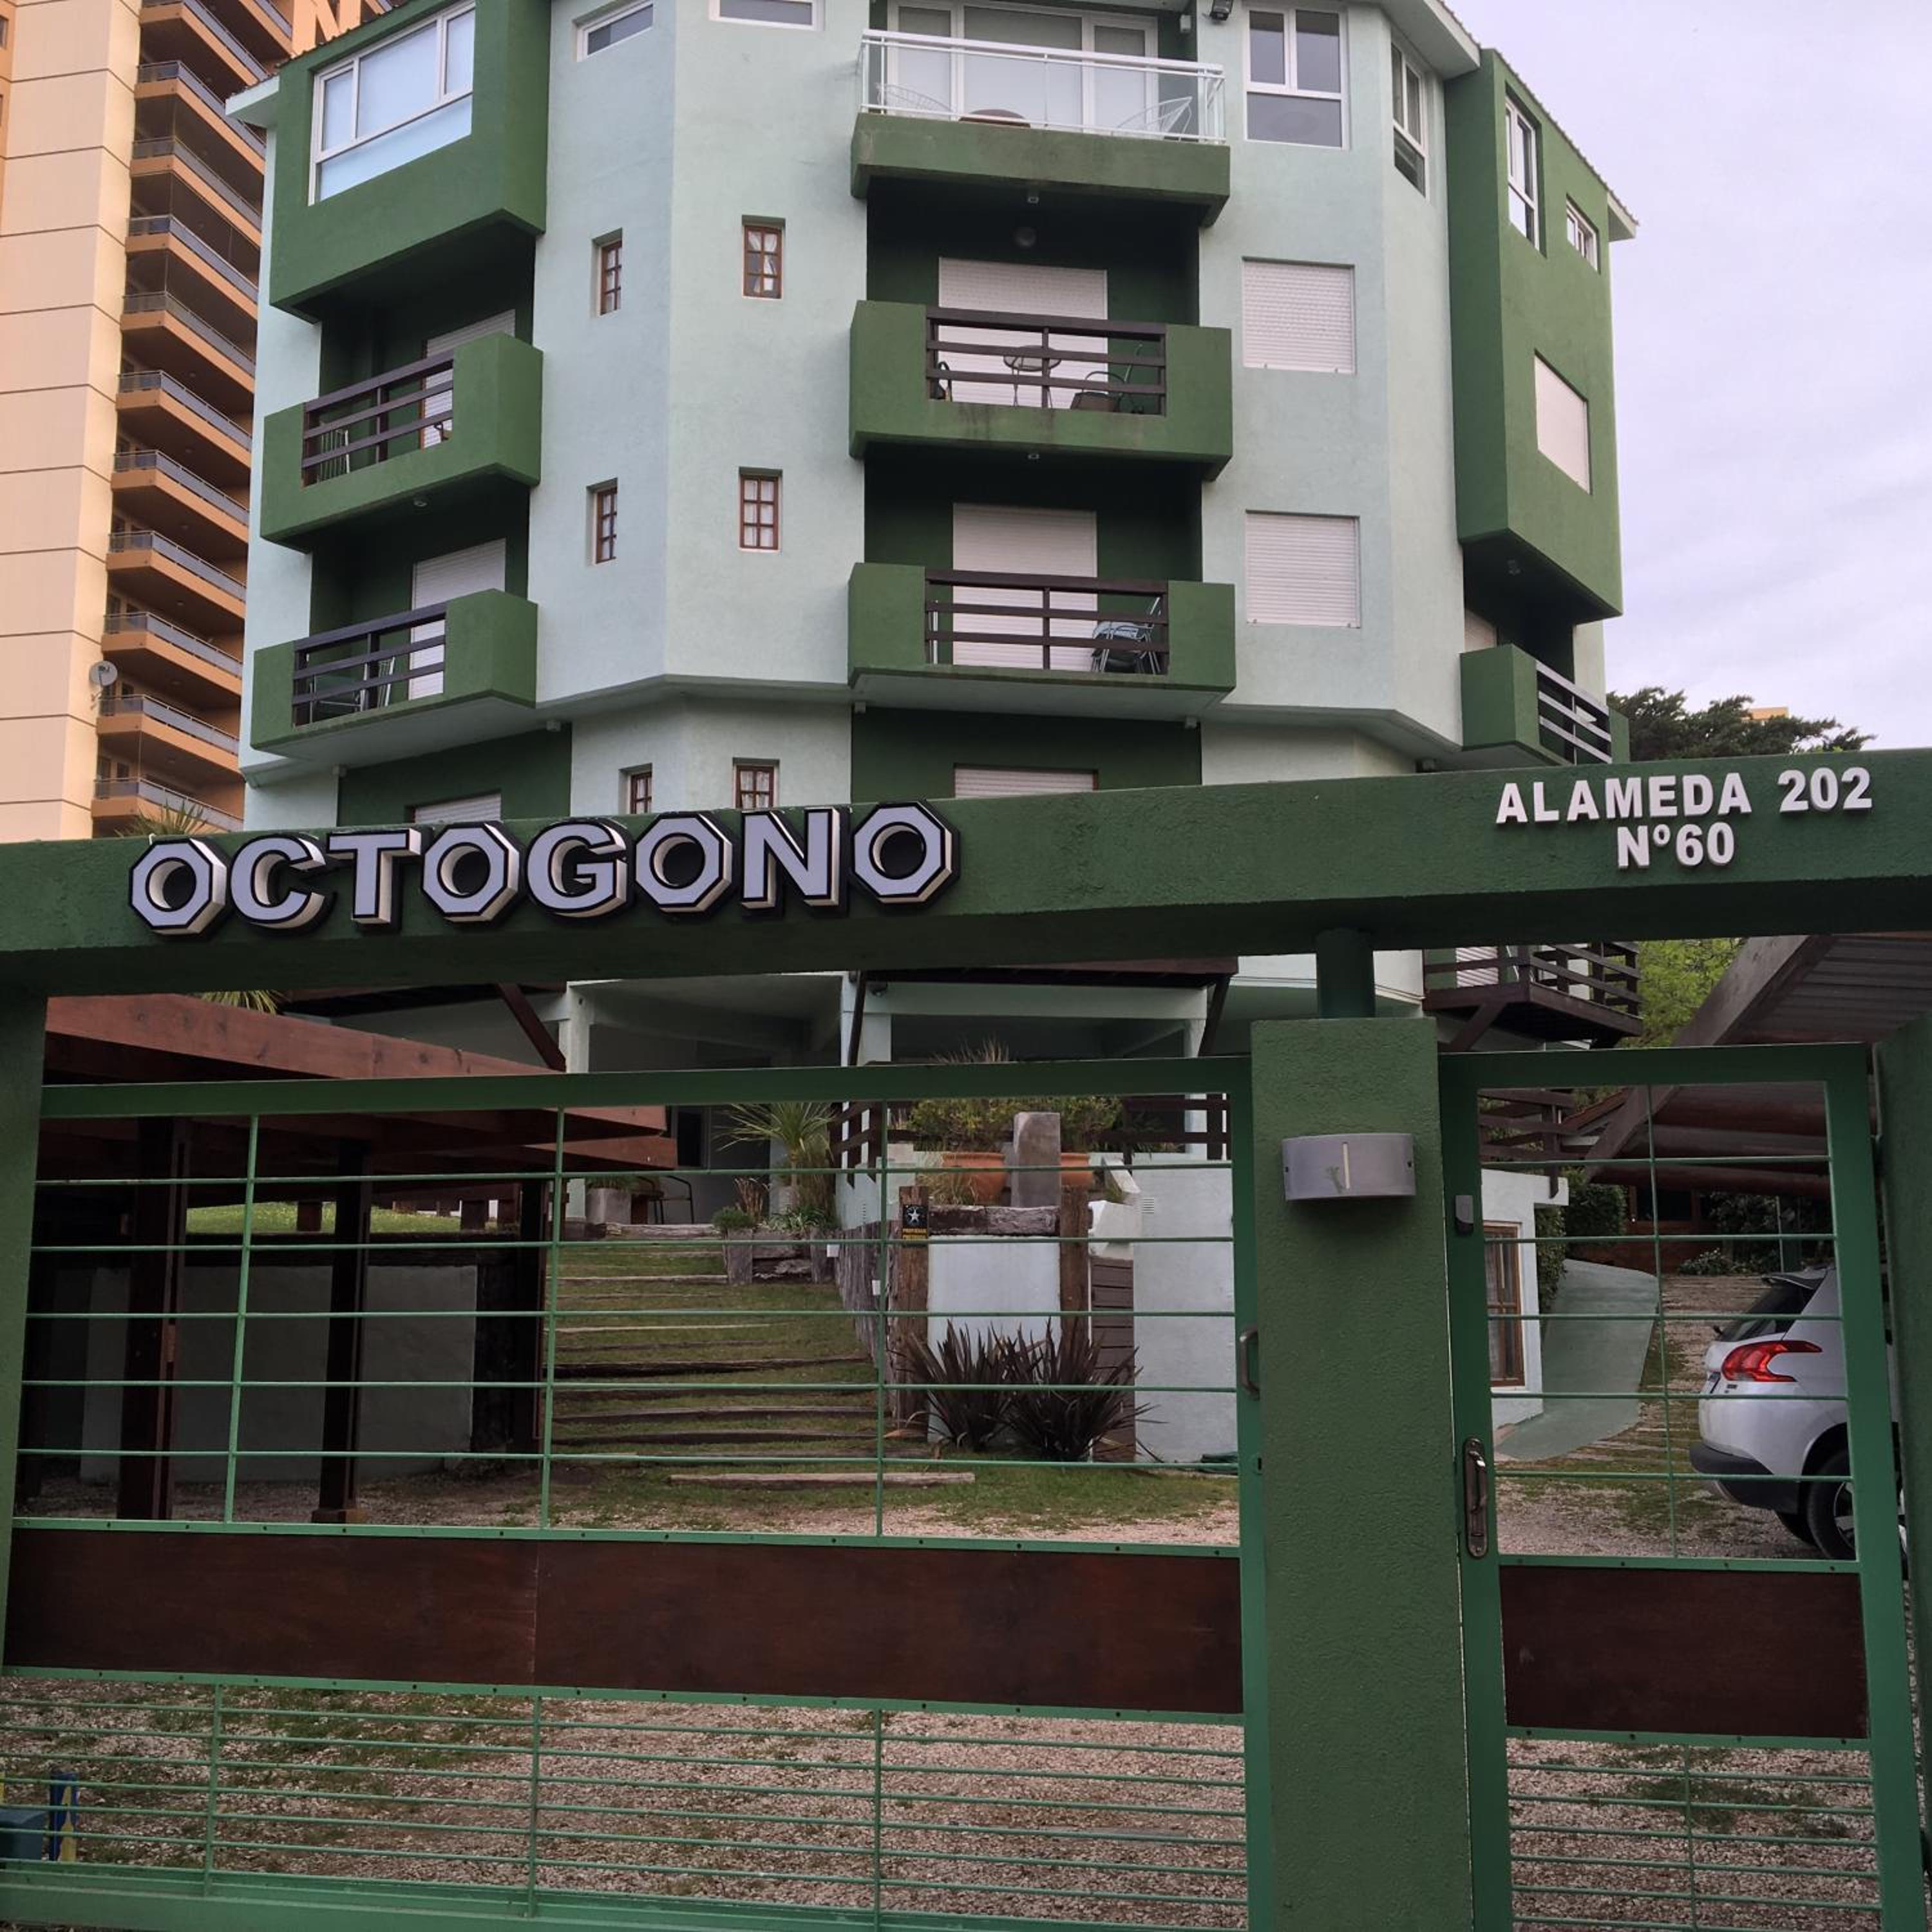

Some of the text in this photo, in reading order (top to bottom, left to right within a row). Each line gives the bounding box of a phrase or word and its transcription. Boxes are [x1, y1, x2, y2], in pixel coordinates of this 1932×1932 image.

[1496, 767, 1872, 824] ALAMEDA 202
[131, 802, 956, 935] OCTOGONO
